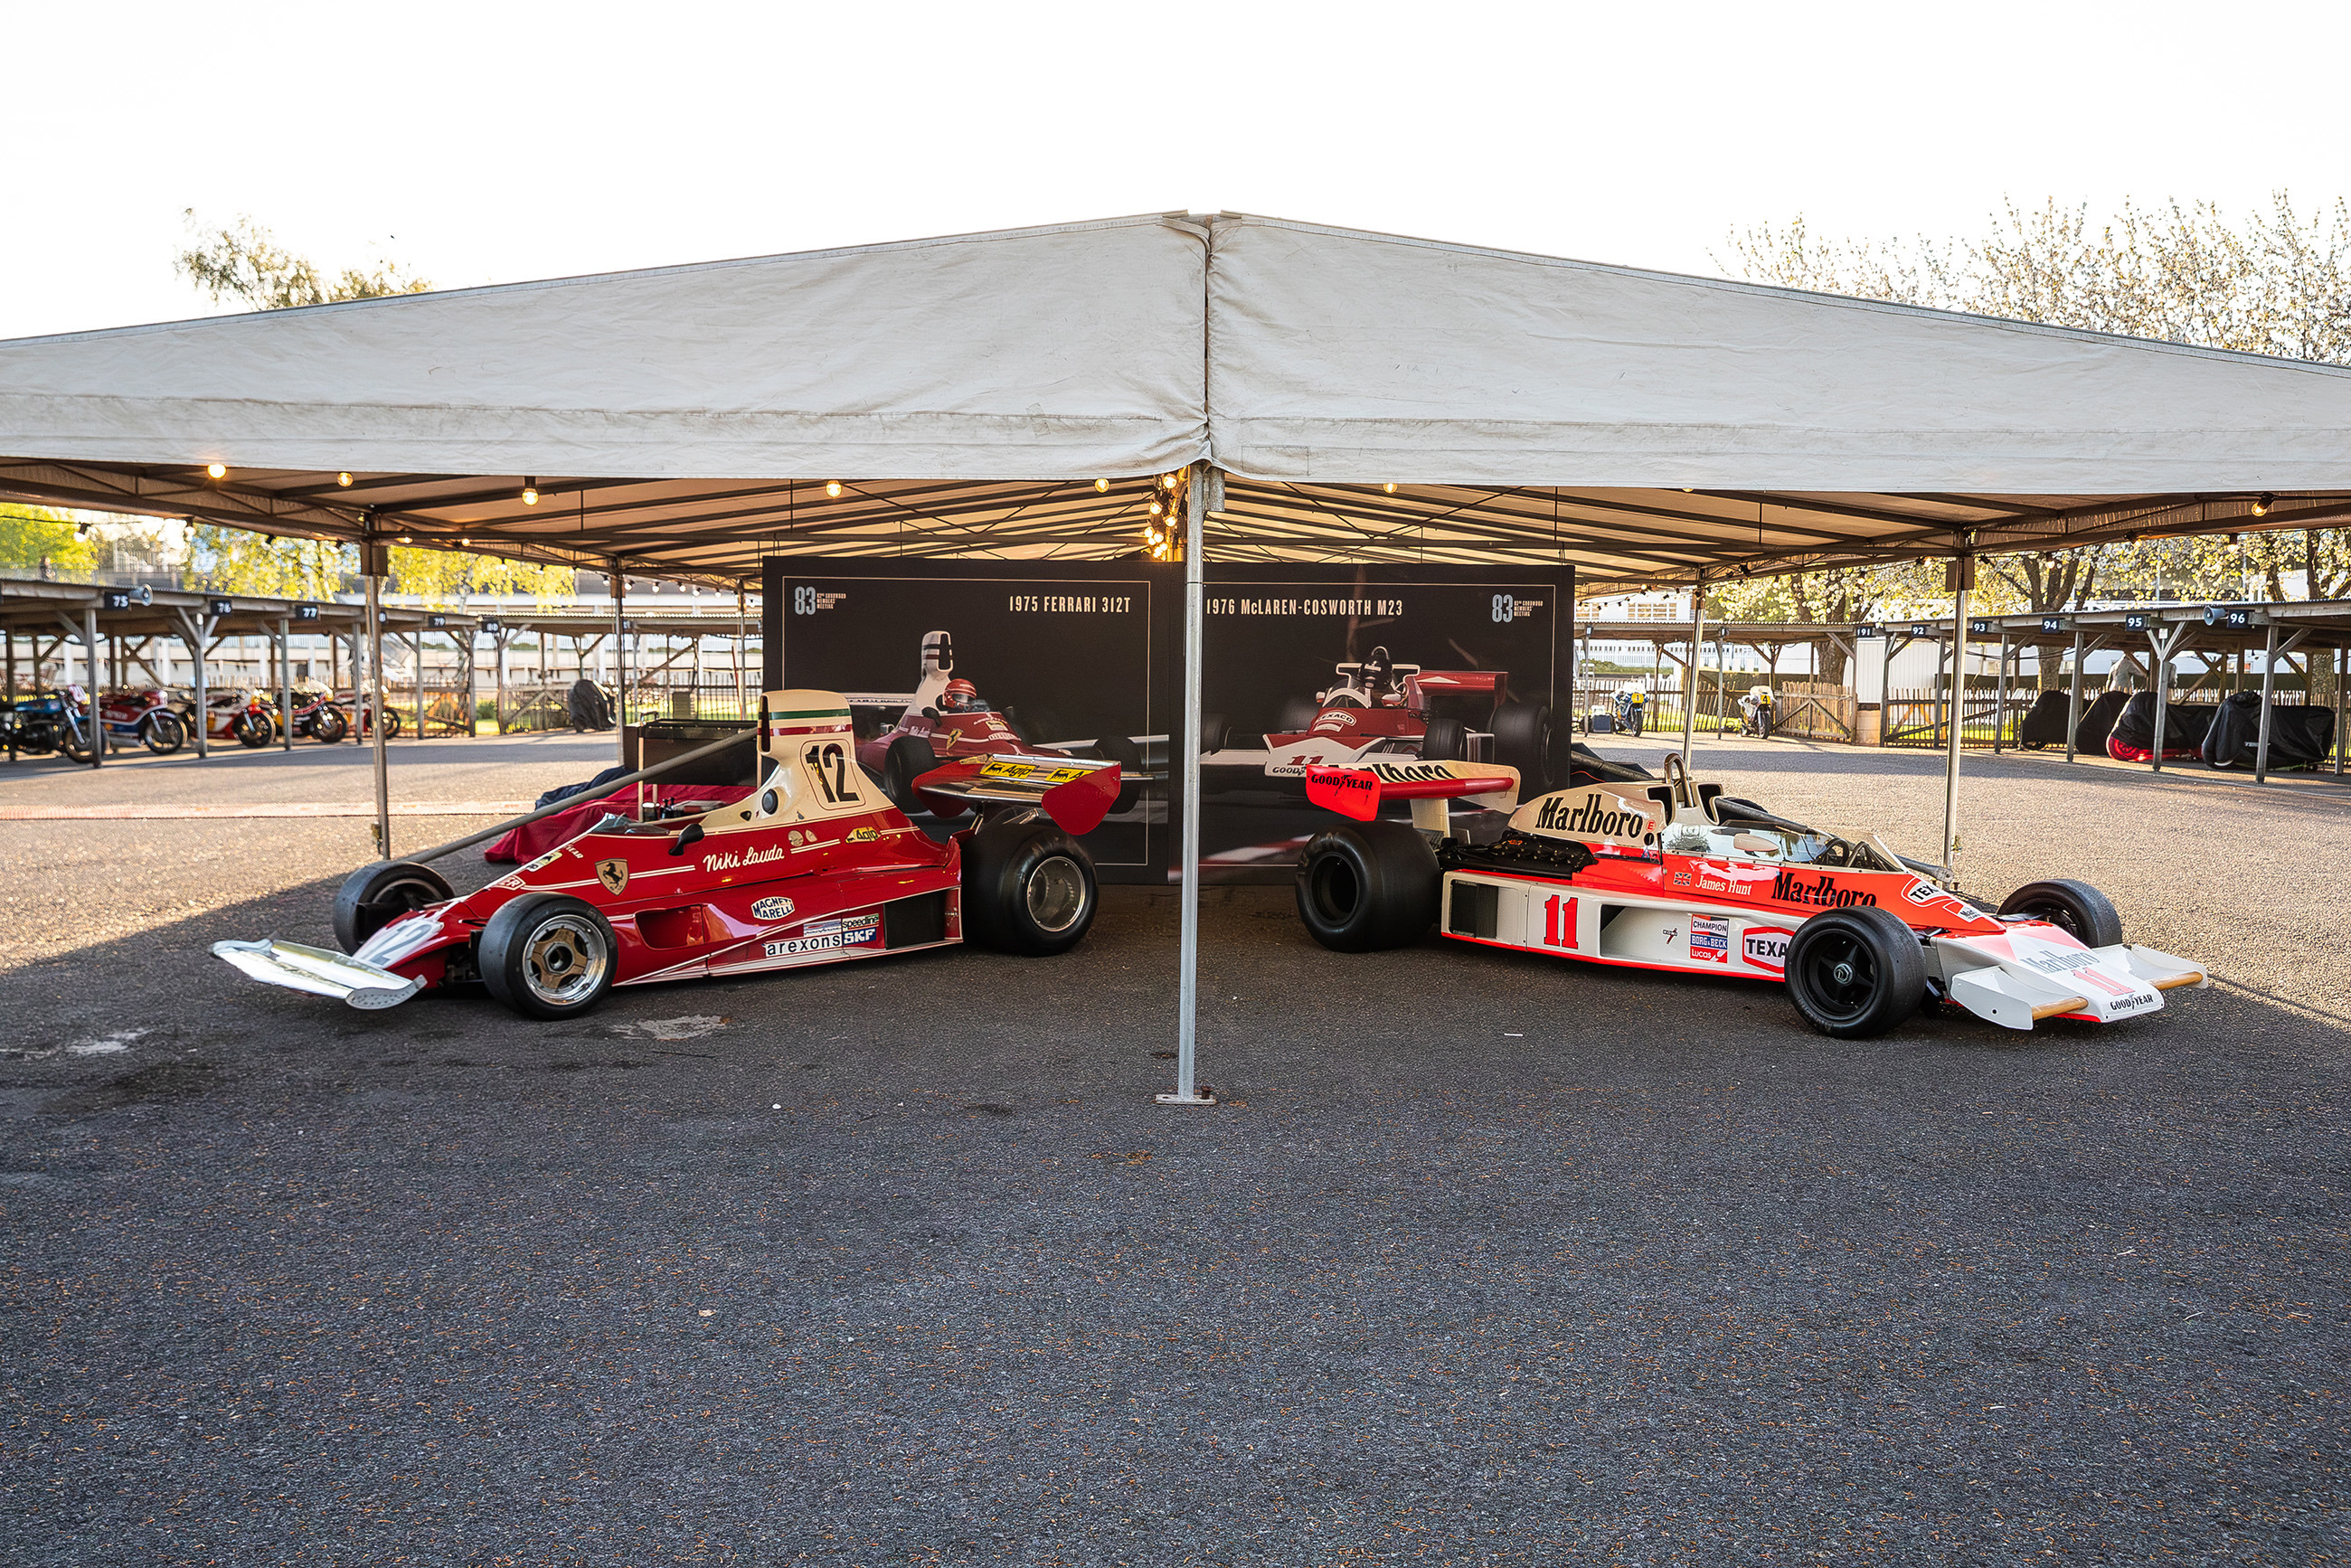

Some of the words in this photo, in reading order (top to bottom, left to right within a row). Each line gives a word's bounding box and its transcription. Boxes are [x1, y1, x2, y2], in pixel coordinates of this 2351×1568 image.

[112, 595, 128, 608] 75
[217, 602, 231, 613] 76
[795, 586, 816, 615] 83
[1009, 595, 1038, 612] 1975
[1043, 596, 1096, 613] FERRARI
[1101, 597, 1130, 613] 312T
[1206, 598, 1235, 615] 1976
[1241, 599, 1372, 616] McLAREN-COSWORTH
[1377, 600, 1402, 616] M23
[1492, 594, 1513, 622] 83
[2044, 620, 2057, 630] 94
[2128, 617, 2142, 628] 95
[2230, 613, 2245, 624] 96
[1912, 627, 1924, 635] 92
[1974, 623, 1986, 632] 93
[1318, 713, 1353, 723] EXACO
[1287, 755, 1324, 766] 11
[805, 742, 861, 804] 12
[1003, 764, 1032, 777] Agip
[1535, 793, 1644, 838] Marlboro
[1647, 821, 1655, 830] E
[855, 829, 879, 840] Agip
[703, 850, 741, 873] Niki
[742, 844, 785, 866] Lauda
[1695, 874, 1726, 892] James
[1727, 879, 1752, 896] Hunt
[1771, 871, 1877, 908] Marlboro
[1543, 893, 1579, 950] 11
[1693, 921, 1727, 932] CHAMPION
[767, 934, 841, 956] arexons
[844, 929, 875, 945] SKF
[1691, 949, 1712, 959] Lucas
[1746, 938, 1787, 958] TEXA
[2020, 949, 2101, 974] Marlboro
[2071, 967, 2136, 997] 11
[2110, 994, 2154, 1011] GOODYEAR
